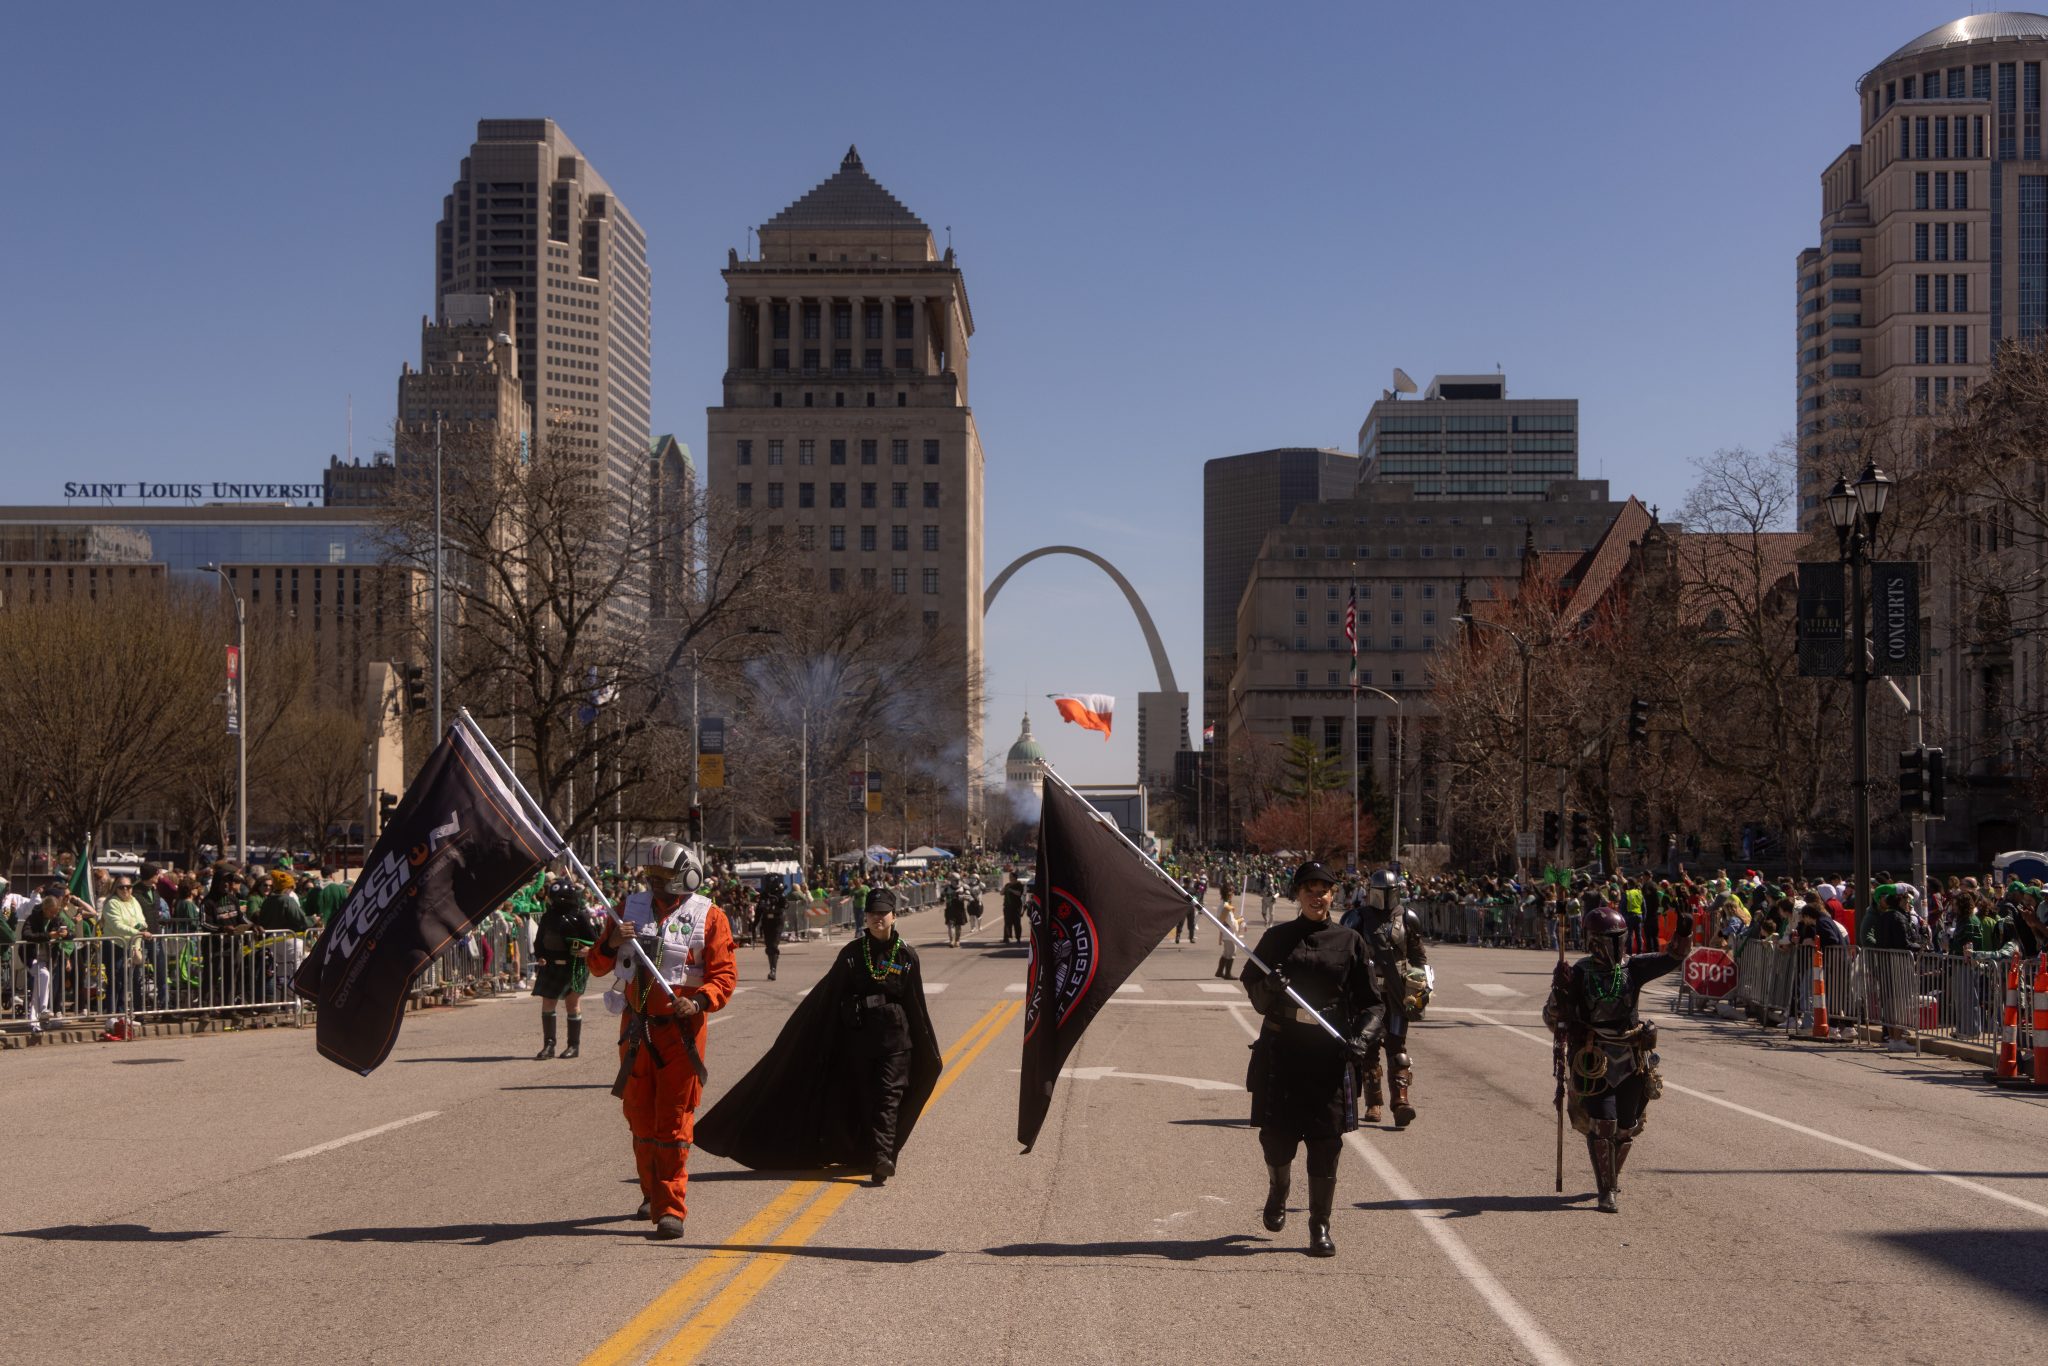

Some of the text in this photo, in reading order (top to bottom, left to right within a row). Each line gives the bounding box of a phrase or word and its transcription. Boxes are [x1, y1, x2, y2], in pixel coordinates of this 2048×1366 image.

[64, 482, 126, 498] SAINT
[138, 482, 202, 498] LOUIS
[1888, 578, 1905, 659] CONCERTS
[1066, 922, 1088, 997] LEGION
[1687, 961, 1735, 983] STOP
